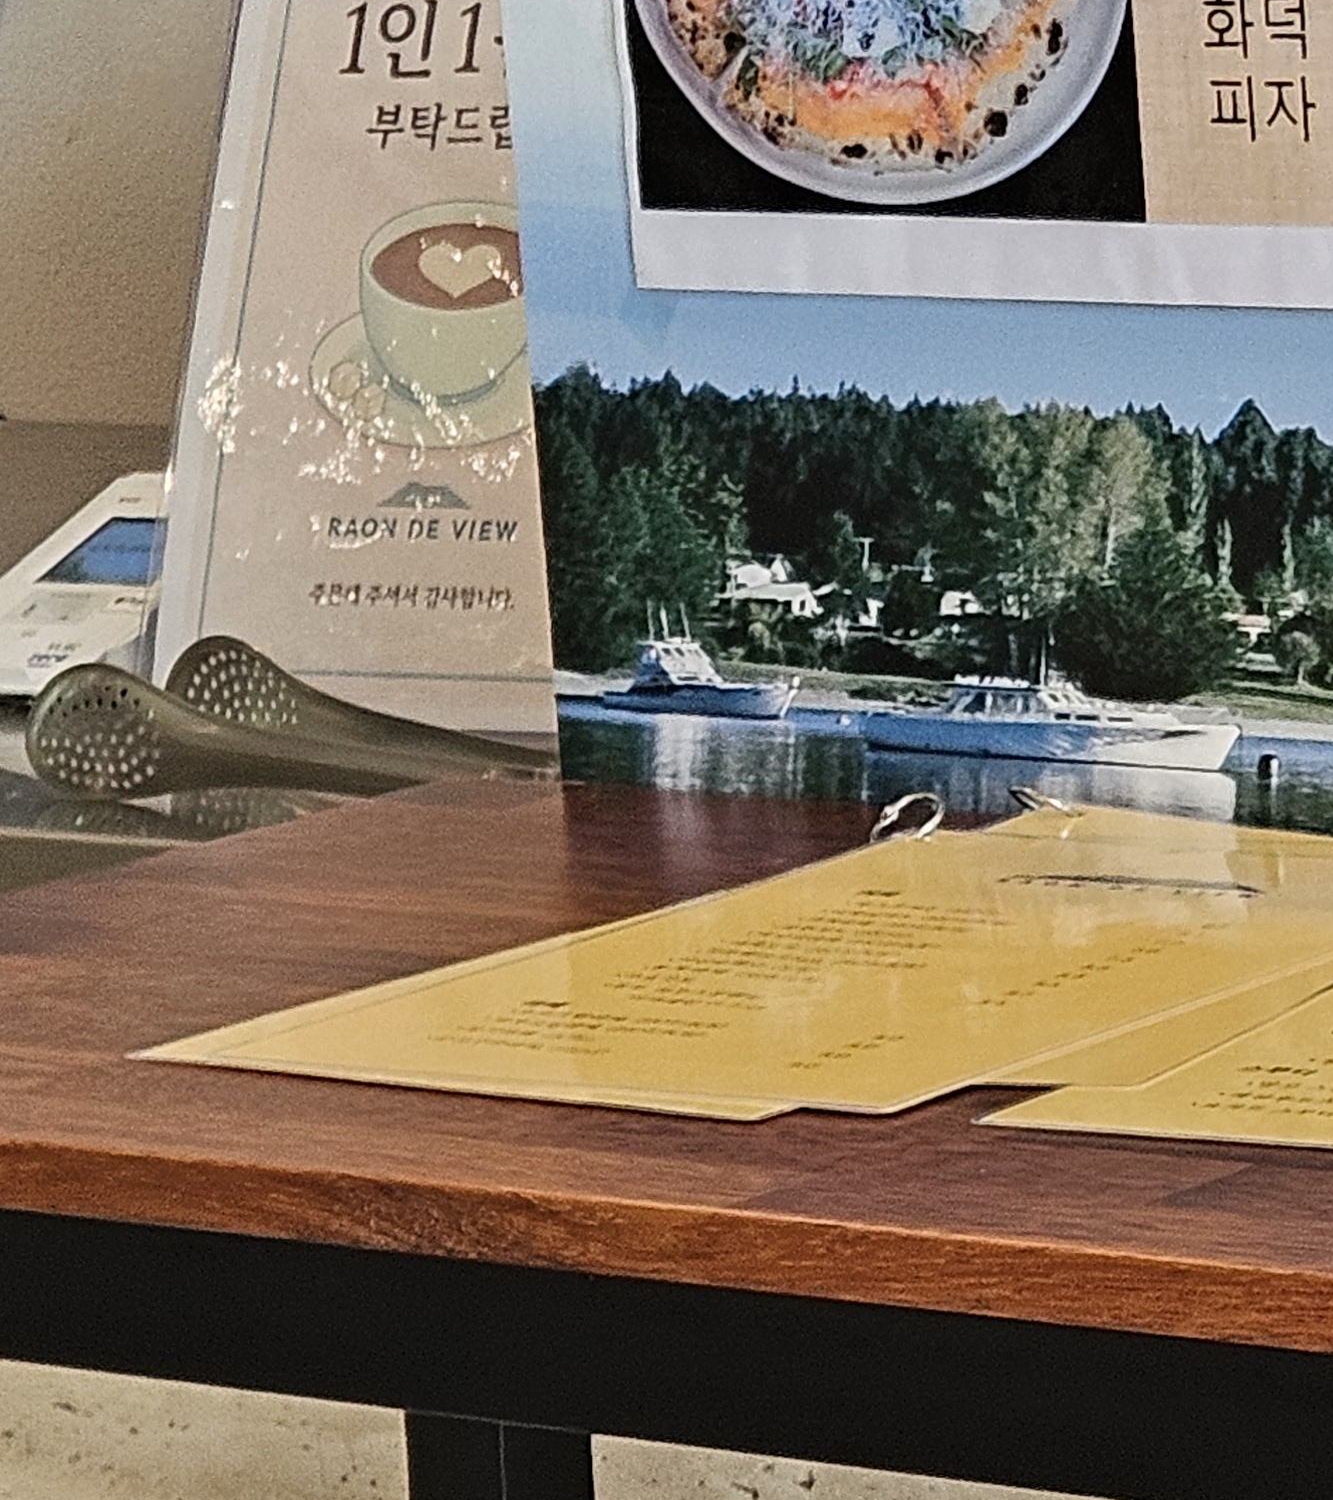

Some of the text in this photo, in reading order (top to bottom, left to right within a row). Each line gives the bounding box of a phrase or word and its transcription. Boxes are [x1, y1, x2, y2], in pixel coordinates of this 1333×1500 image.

[453, 2, 507, 79] 1
[1209, 74, 1317, 143] 피자
[327, 517, 518, 542] RAON DE VIEW
